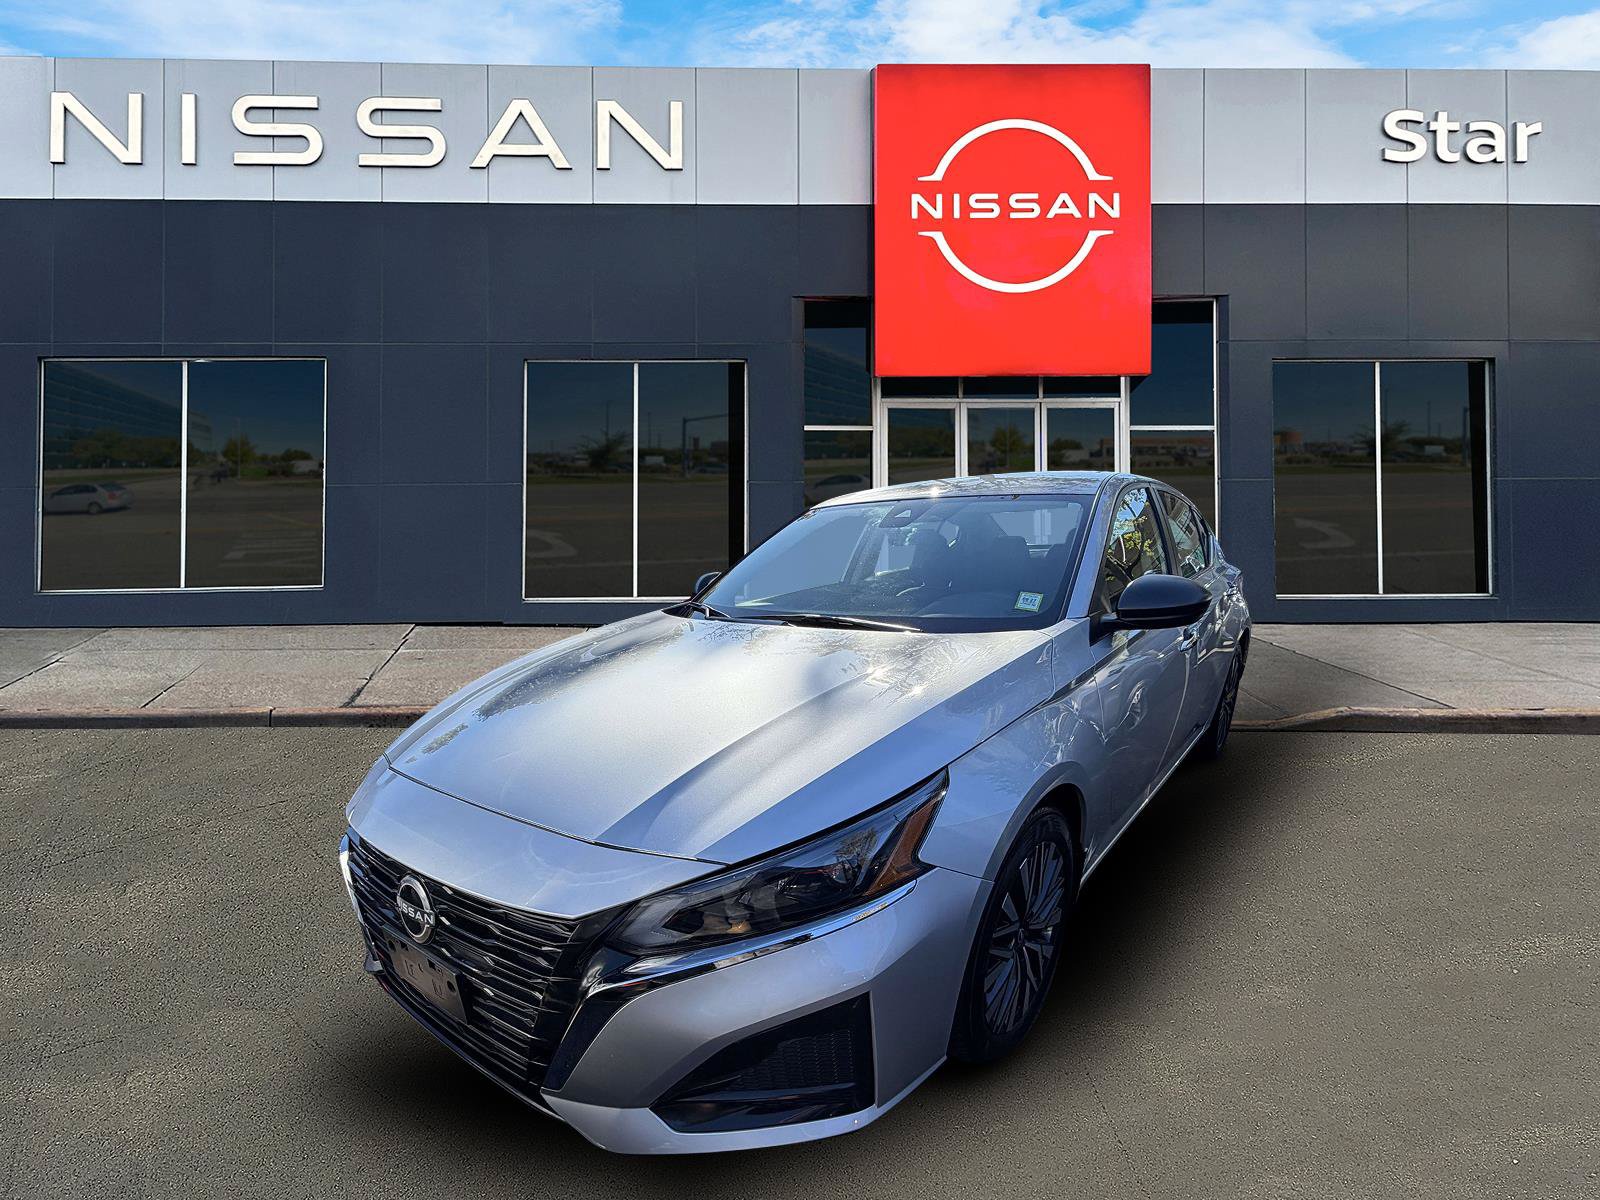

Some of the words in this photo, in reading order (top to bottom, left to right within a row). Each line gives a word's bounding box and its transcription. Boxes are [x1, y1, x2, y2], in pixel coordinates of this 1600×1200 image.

[50, 91, 683, 170] NISSAN
[1381, 108, 1543, 164] Star
[910, 192, 1121, 219] NISSAN
